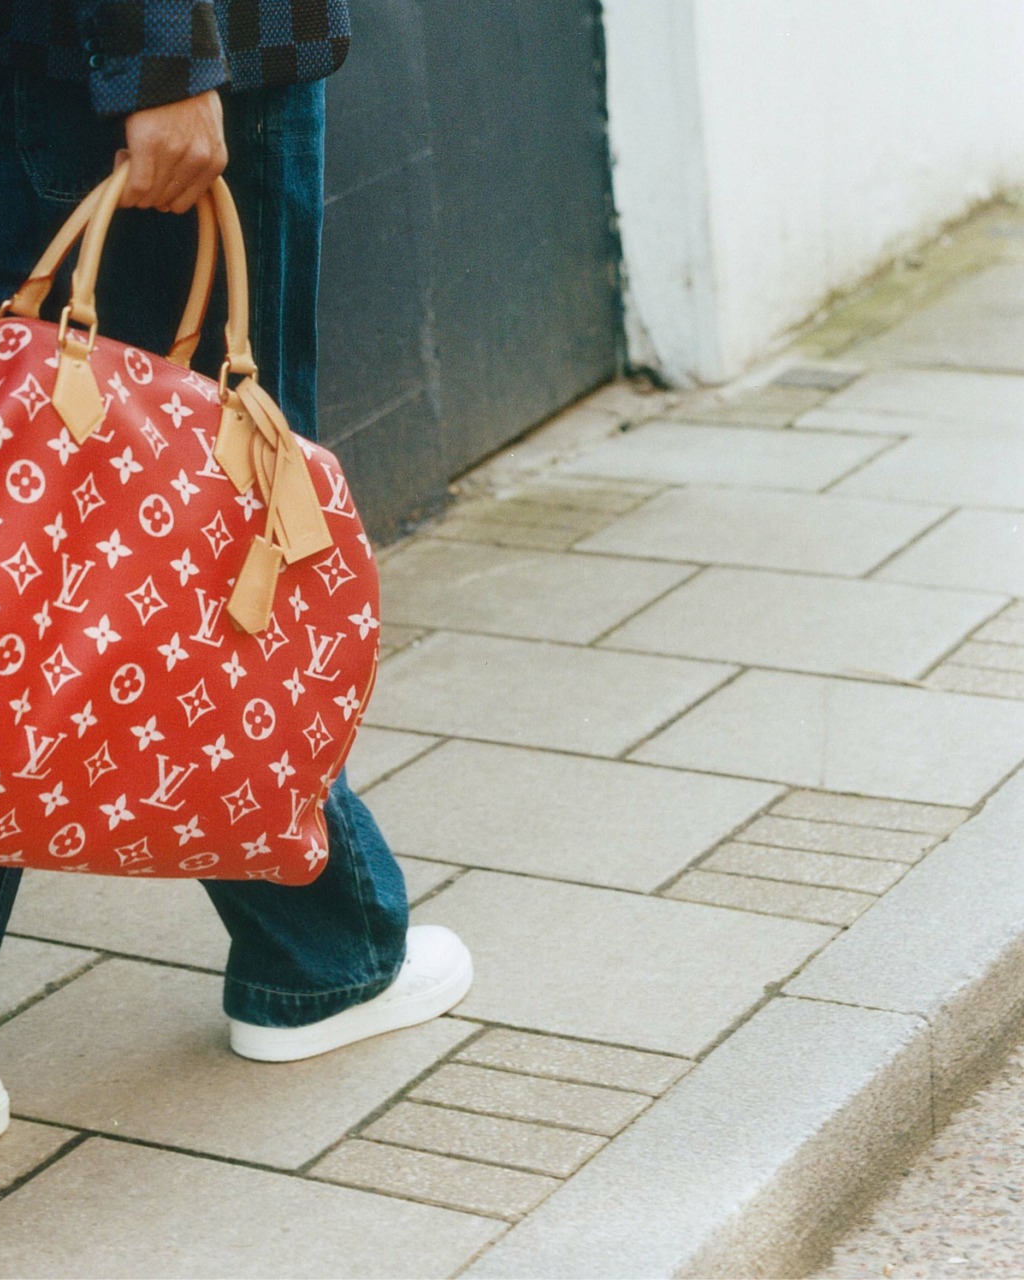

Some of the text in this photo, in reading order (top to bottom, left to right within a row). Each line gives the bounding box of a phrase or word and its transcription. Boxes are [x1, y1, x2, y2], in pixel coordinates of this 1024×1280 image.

[53, 553, 95, 613] LV
[189, 588, 226, 647] LV
[304, 624, 346, 681] LV
[12, 725, 67, 780] LV
[139, 754, 198, 811] LV
